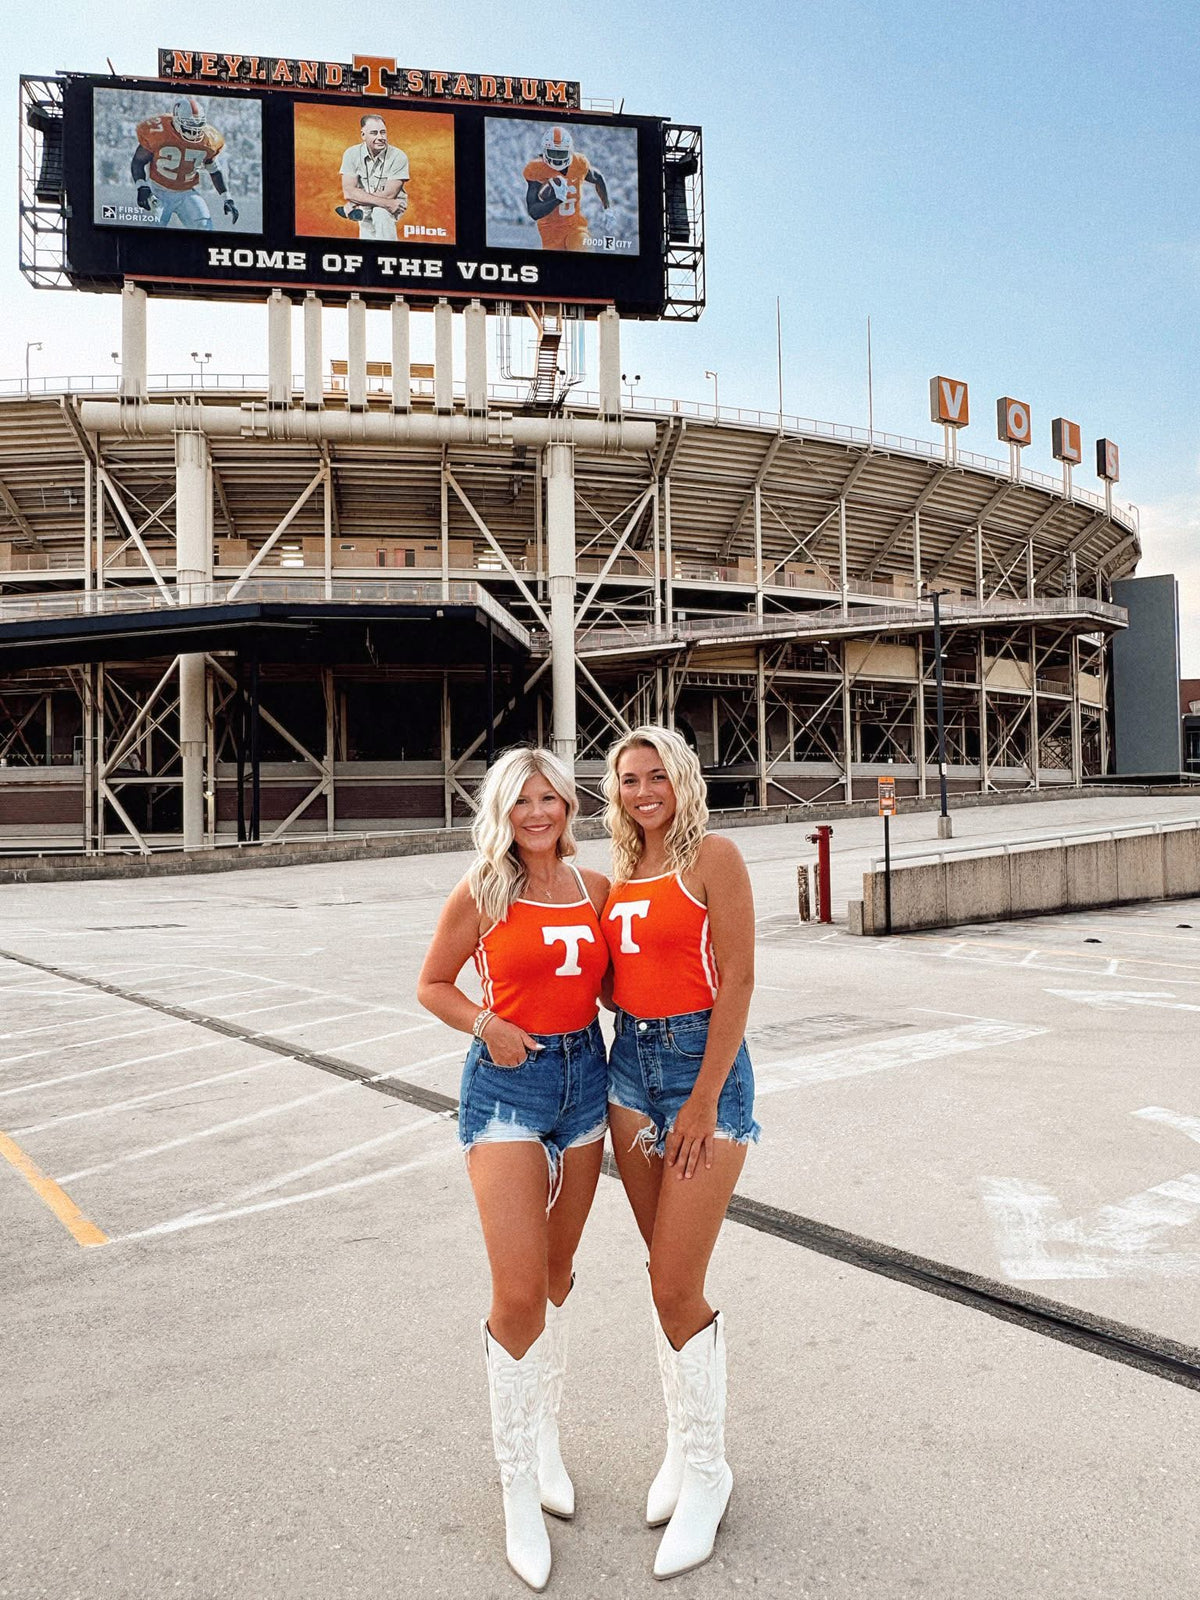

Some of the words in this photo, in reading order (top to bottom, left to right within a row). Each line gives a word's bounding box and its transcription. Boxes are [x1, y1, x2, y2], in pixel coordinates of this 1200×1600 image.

[172, 51, 342, 85] NEYLAND
[351, 53, 397, 96] T
[407, 70, 567, 103] STADIUM
[155, 146, 208, 183] 27
[119, 206, 145, 214] FIRST
[119, 214, 161, 223] HORIZON
[582, 238, 603, 247] FOOD
[615, 240, 632, 249] CITY
[208, 247, 307, 270] HOME
[322, 254, 363, 273] OF
[377, 256, 443, 278] THE
[457, 262, 539, 283] VOLS
[608, 900, 651, 954] T
[541, 925, 595, 976] T
